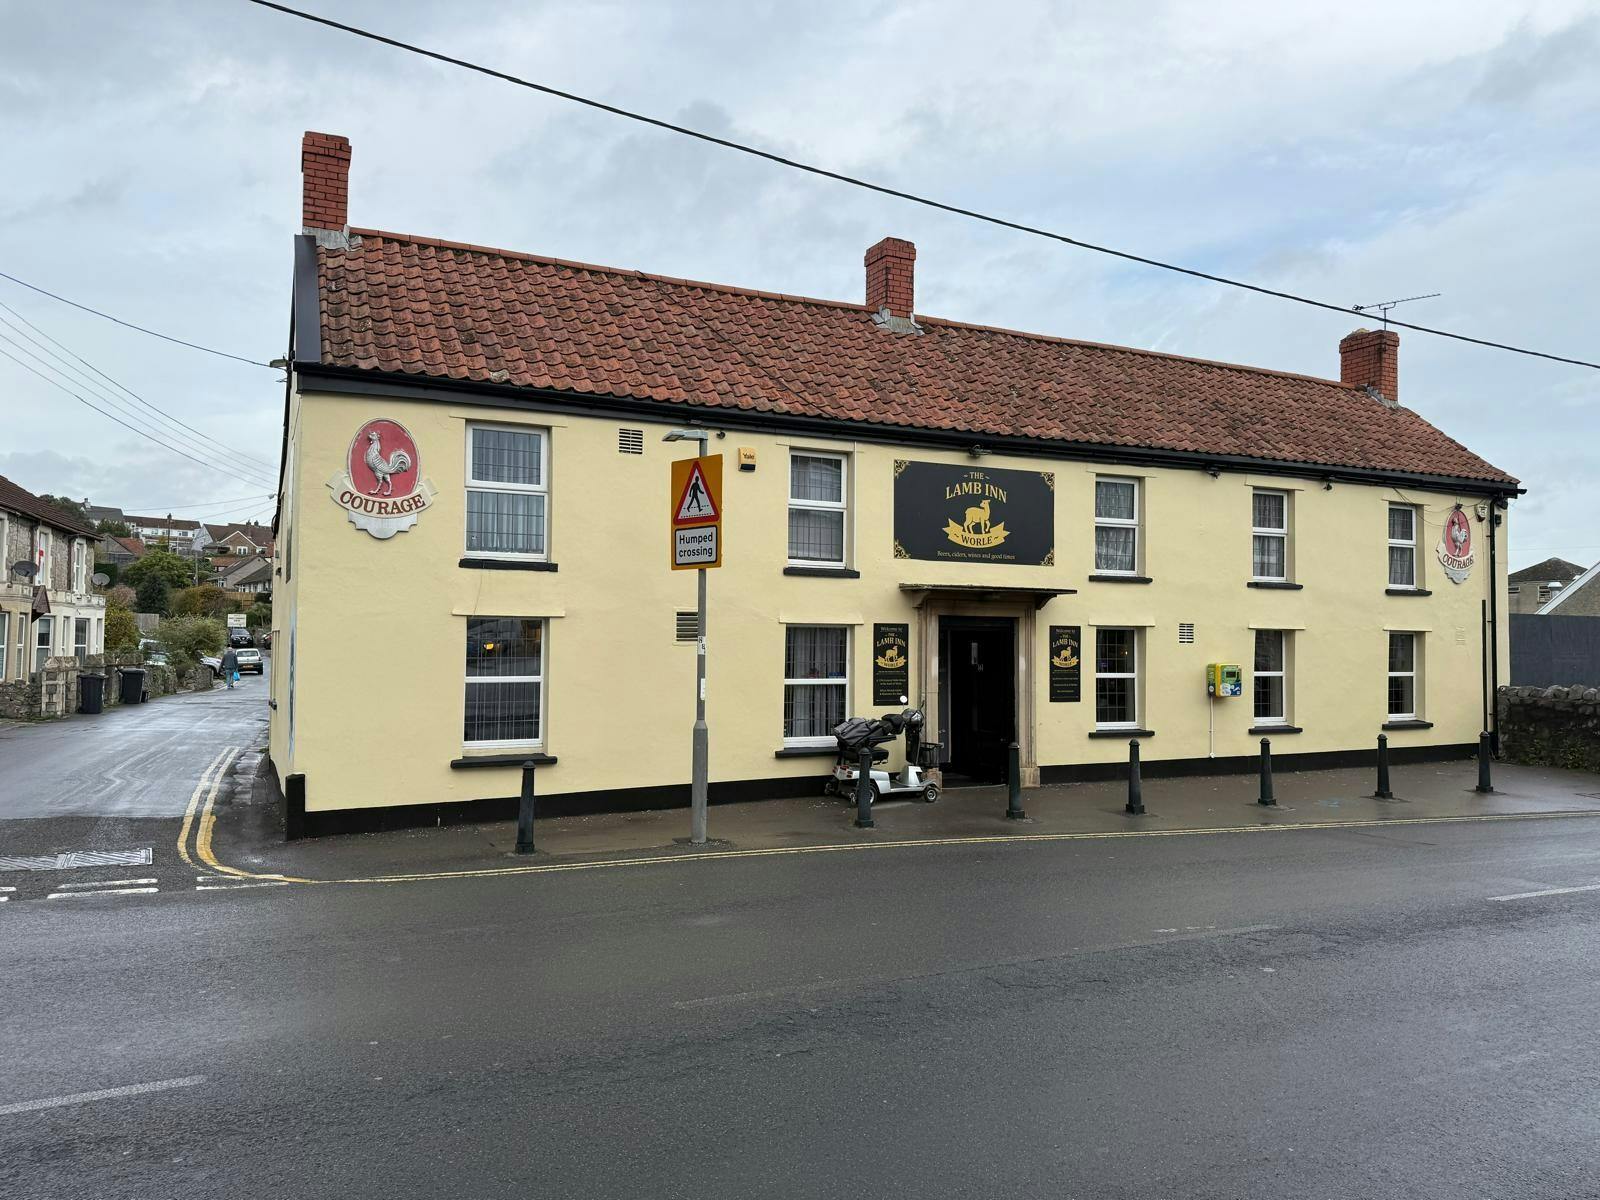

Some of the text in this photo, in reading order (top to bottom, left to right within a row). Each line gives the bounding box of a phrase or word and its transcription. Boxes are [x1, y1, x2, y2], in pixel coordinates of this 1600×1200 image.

[946, 482, 1006, 504] LAMB INN
[340, 490, 426, 515] COURAGE
[679, 532, 713, 545] Humped
[961, 534, 993, 546] WORLE
[678, 546, 713, 557] crossing
[1442, 554, 1475, 569] COURAGE
[876, 637, 906, 647] LAMB INN
[1052, 638, 1078, 648] LAMB INN
